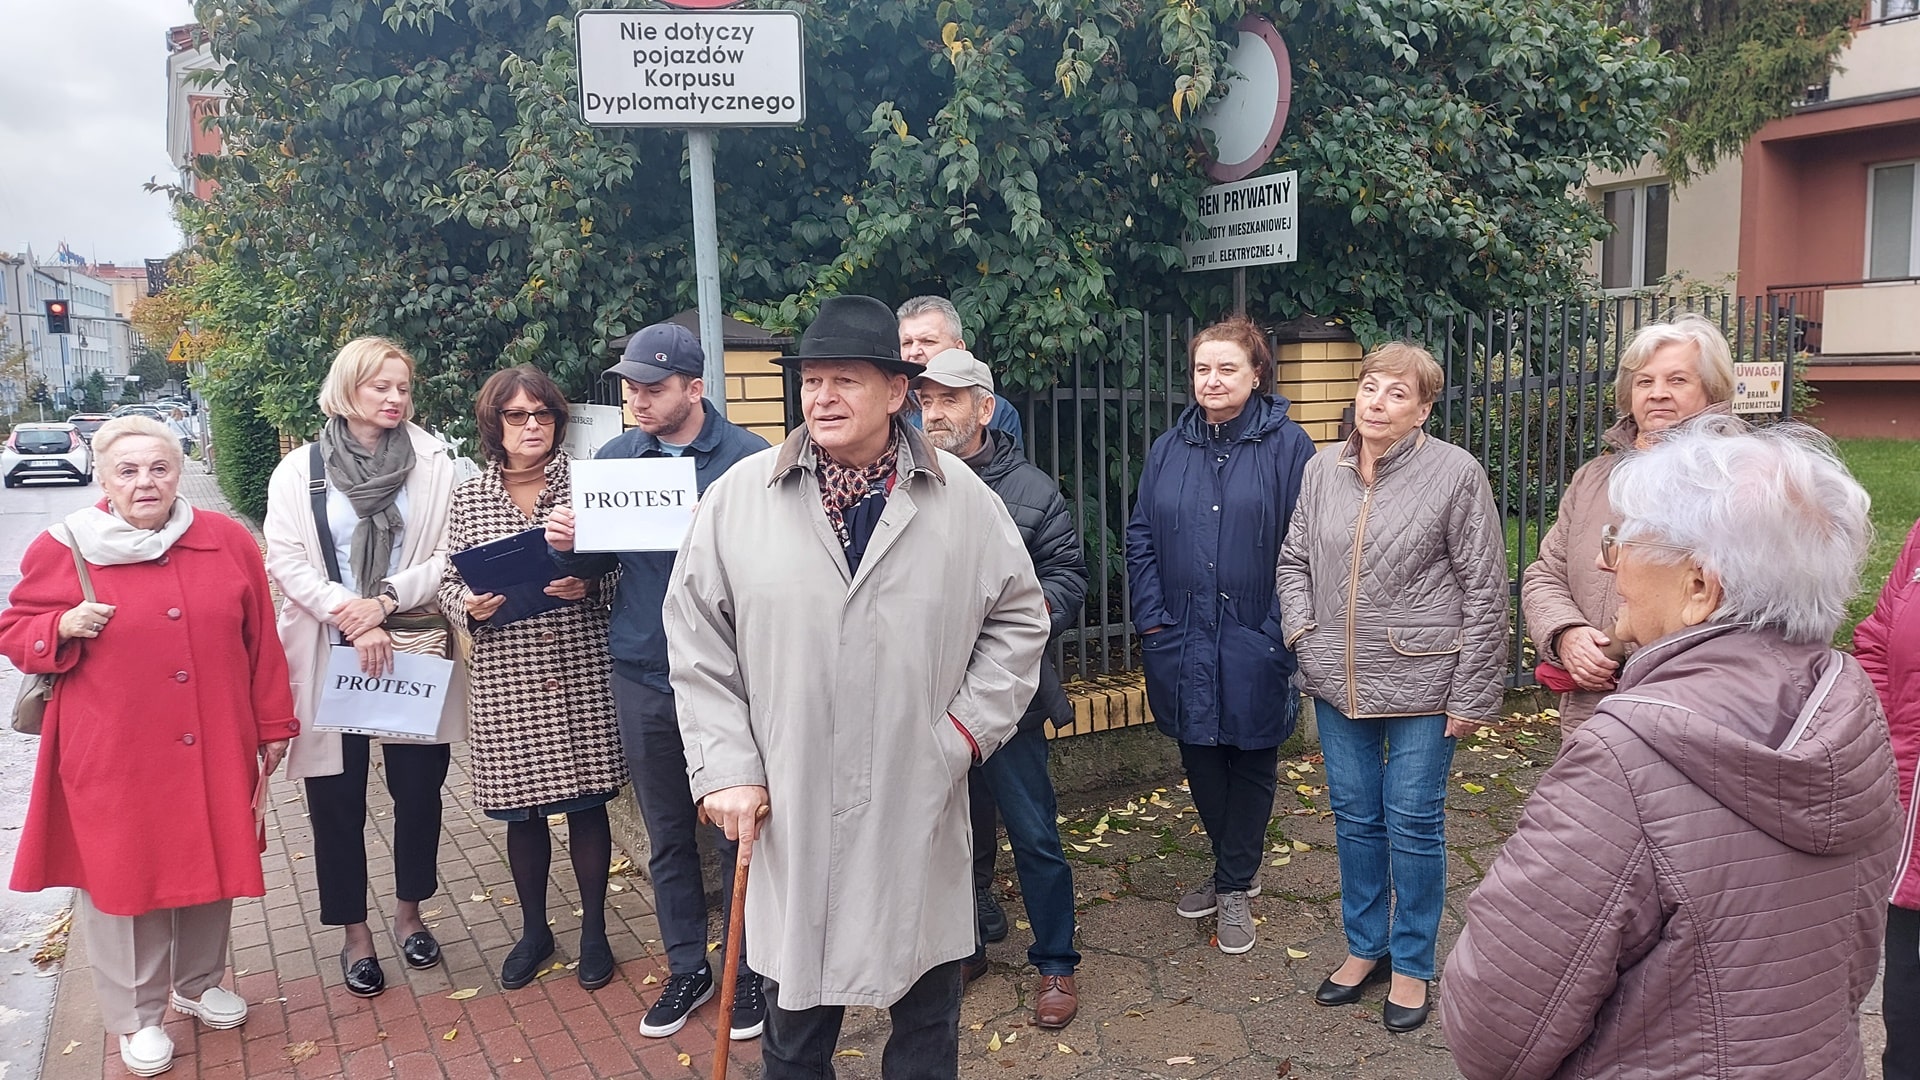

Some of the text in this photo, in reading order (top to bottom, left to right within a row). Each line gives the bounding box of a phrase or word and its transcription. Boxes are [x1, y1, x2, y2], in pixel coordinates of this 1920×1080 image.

[620, 22, 754, 44] Nie dotyczy
[633, 45, 744, 67] pojazdów
[645, 69, 735, 90] Korpusu
[586, 92, 795, 114] Dyplomatycznego
[1198, 181, 1291, 217] REN PRYWATNY
[1228, 217, 1292, 237] MIESZKANIOWEJ
[1192, 243, 1283, 268] przy ul. ELEKTRYCZNEJ 4
[1736, 366, 1781, 377] UWAGA!
[1733, 401, 1780, 410] AUTOMATYCZNA
[1747, 391, 1769, 399] BRAMA
[584, 489, 685, 508] PROTEST
[335, 674, 436, 698] PROTEST
